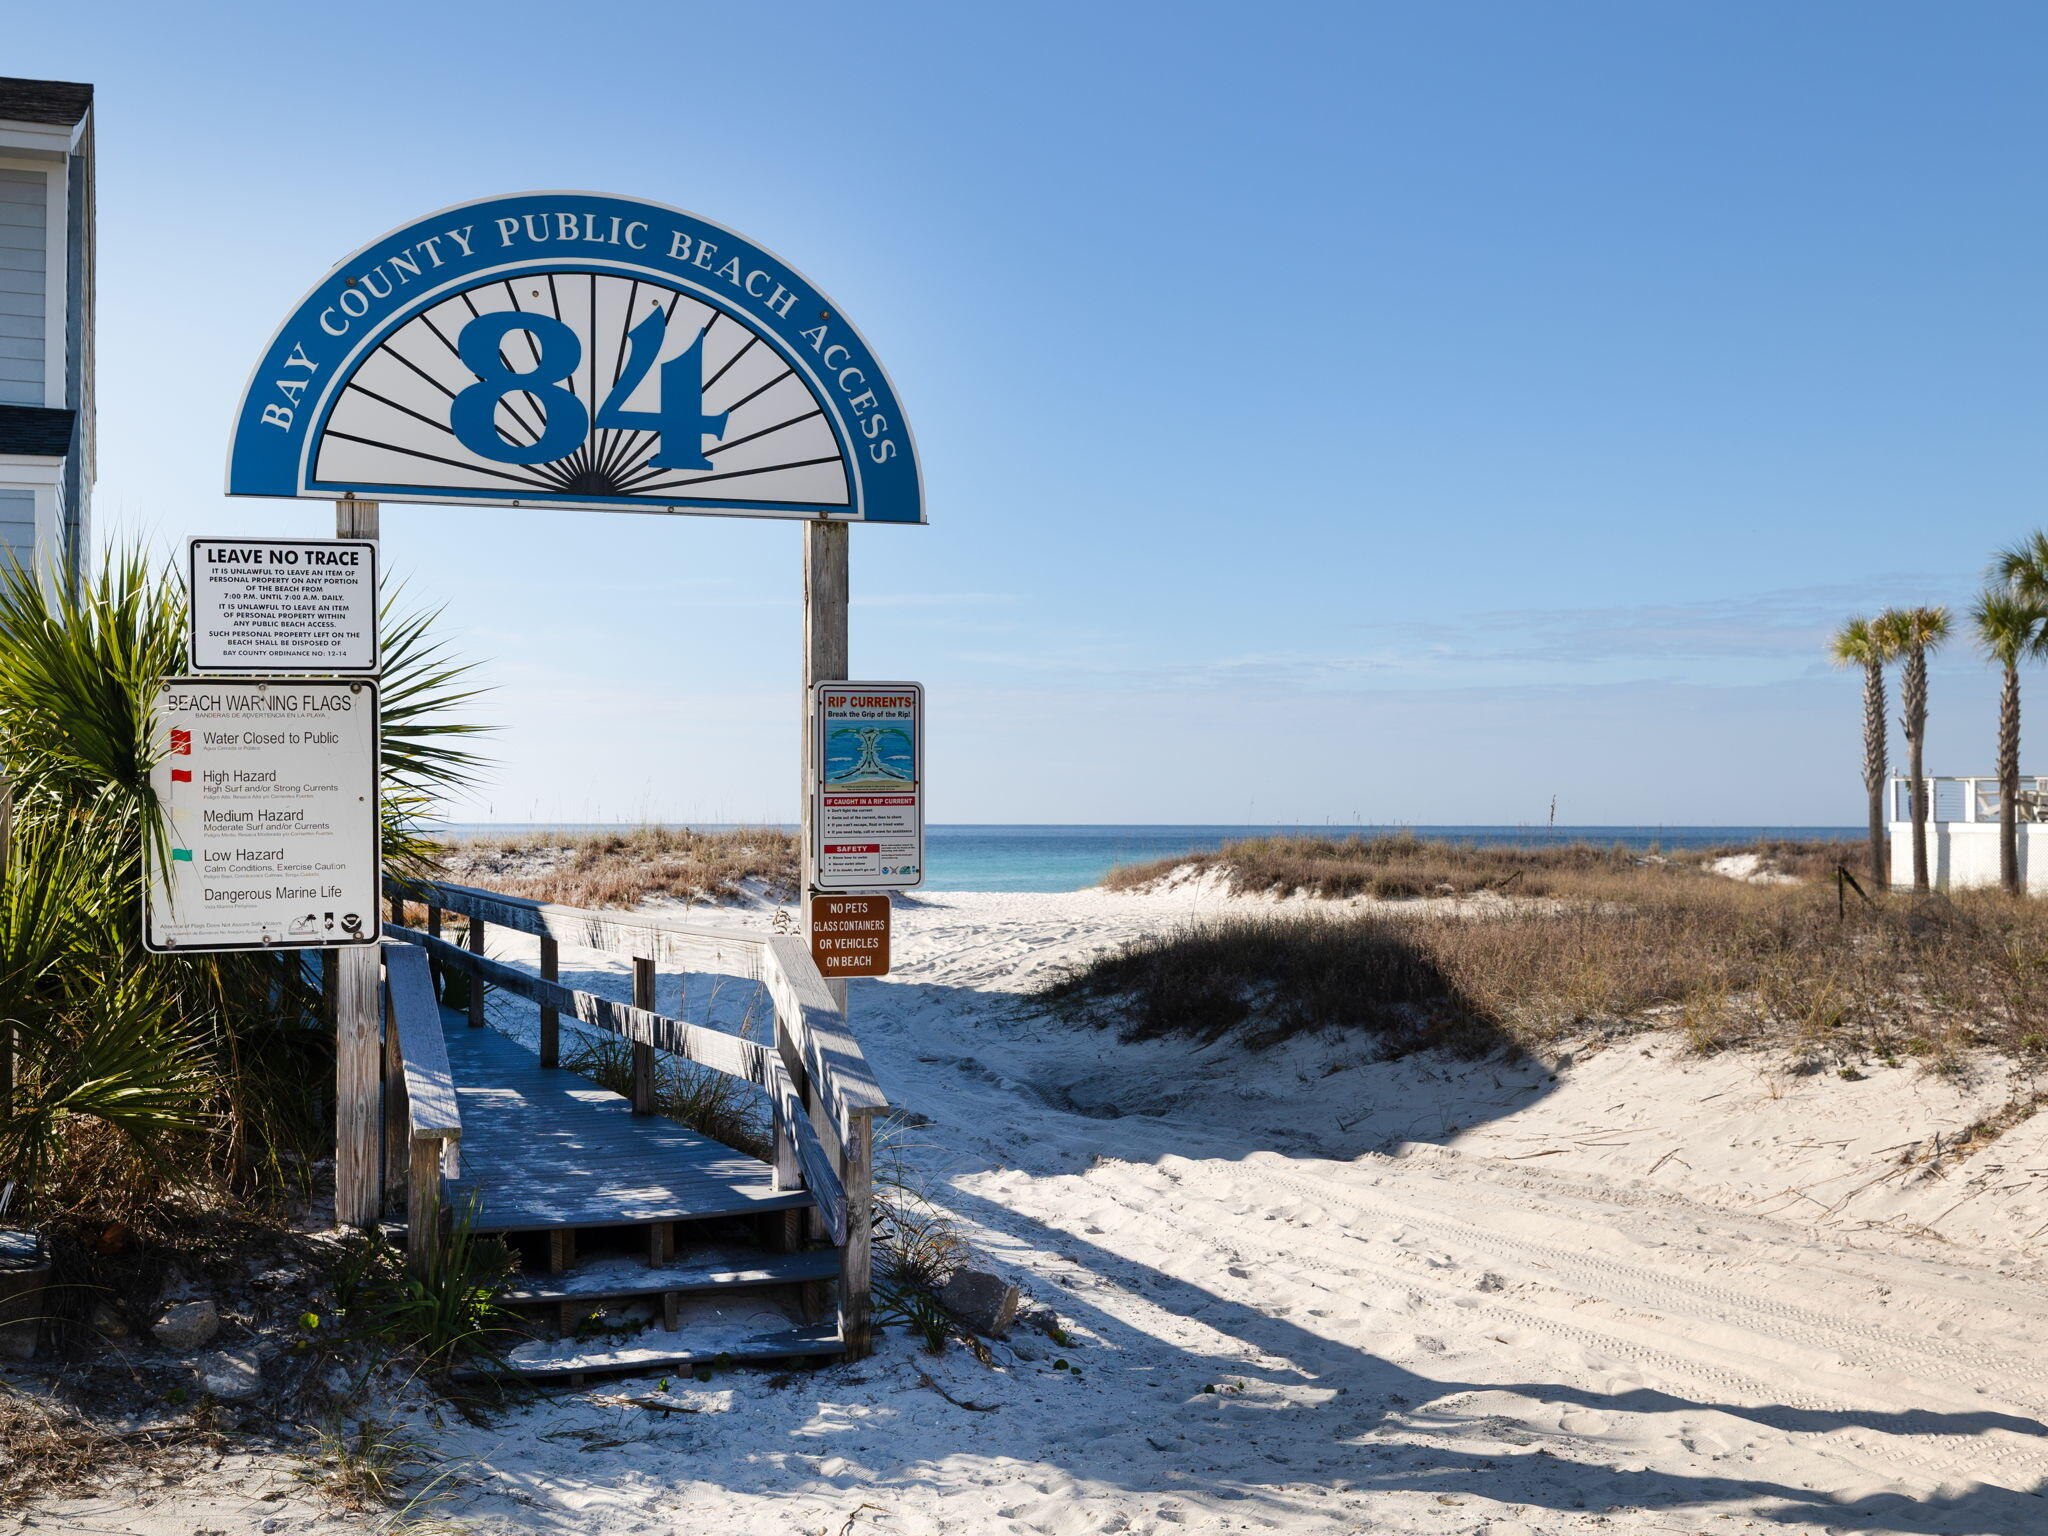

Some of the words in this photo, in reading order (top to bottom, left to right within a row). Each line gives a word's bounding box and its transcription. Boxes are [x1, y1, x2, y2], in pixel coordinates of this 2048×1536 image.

[261, 341, 320, 433] BAY
[319, 226, 479, 337] COUNTY
[495, 213, 649, 250] PUBLIC
[668, 230, 800, 320] BEACH
[799, 321, 897, 465] ACCESS
[450, 304, 729, 471] 84
[208, 549, 262, 564] LEAVE
[270, 550, 298, 565] NO
[305, 551, 359, 566] TRACE
[168, 695, 221, 711] BEACH
[226, 695, 298, 711] WARNING
[303, 695, 351, 711] FLAGS
[828, 696, 847, 708] RIP
[850, 696, 912, 708] CURRENTS
[861, 711, 875, 719] Grip
[898, 711, 911, 719] Rip!
[203, 732, 239, 744] Water
[243, 732, 285, 744] Closed
[289, 733, 300, 744] to
[304, 731, 339, 744] Public
[203, 770, 229, 785] High
[234, 770, 276, 782] Hazard
[203, 785, 222, 794] High
[273, 784, 301, 793] Strong
[303, 784, 338, 792] Currents
[203, 810, 253, 822] Medium
[258, 809, 304, 821] Hazard
[246, 823, 263, 831] Surf
[266, 823, 292, 831] and/or
[294, 822, 330, 830] Currents
[204, 849, 231, 861] Low
[236, 848, 284, 861] Hazard
[277, 863, 312, 871] Exercise
[205, 889, 272, 903] Dangerous
[276, 887, 317, 899] Marine
[321, 886, 342, 898] Life
[830, 903, 843, 914] NO
[845, 903, 868, 913] PETS
[813, 921, 838, 932] GLASS
[839, 920, 885, 931] CONTAINERS
[819, 939, 832, 949] OR
[835, 937, 879, 949] VEHICLES
[826, 957, 839, 967] ON
[841, 956, 872, 966] BEACH
